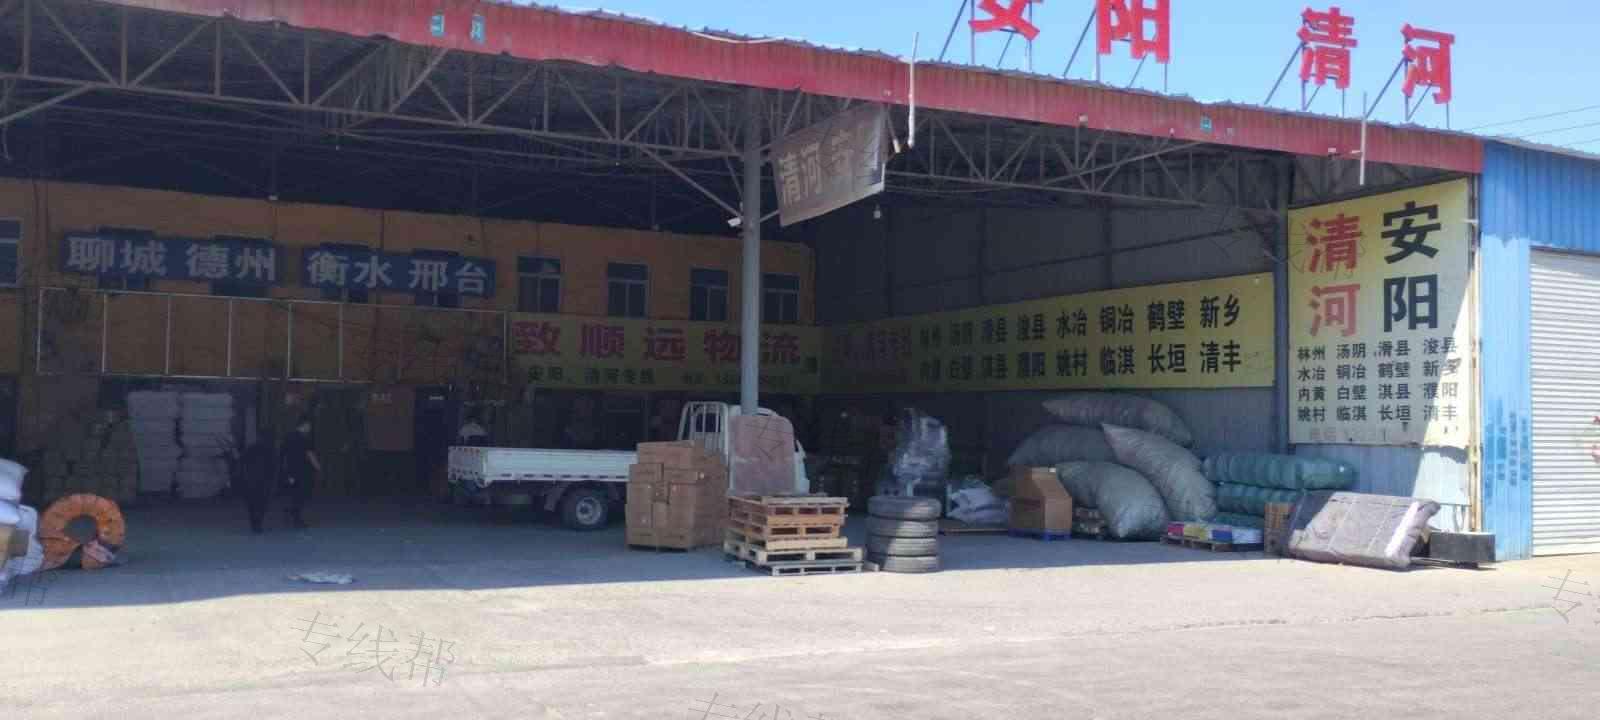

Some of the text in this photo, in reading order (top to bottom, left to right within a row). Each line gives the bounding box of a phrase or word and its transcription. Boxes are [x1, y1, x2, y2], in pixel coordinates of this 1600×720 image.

[1298, 7, 1455, 104] 清河
[66, 236, 276, 281] 聊城 德州
[307, 251, 488, 294] 衡水 邢台
[1305, 213, 1361, 338] 清河
[1381, 201, 1441, 332] 安阳
[1056, 308, 1089, 339] 水冶
[1100, 303, 1136, 335] 铜冶
[1147, 299, 1185, 332] 鹤壁
[1200, 293, 1241, 329] 新乡
[1100, 345, 1136, 377] 临淇
[1147, 342, 1186, 375] 长垣
[1200, 338, 1242, 375] 清丰
[1297, 365, 1326, 382] 水冶
[1336, 363, 1366, 380] 铜冶
[1297, 406, 1326, 423] 姚村
[1336, 405, 1367, 422] 临淇
[1378, 404, 1412, 421] 长垣
[1298, 385, 1327, 402] 内黄
[1337, 384, 1367, 401] 白壁
[1378, 383, 1411, 400] 淇县
